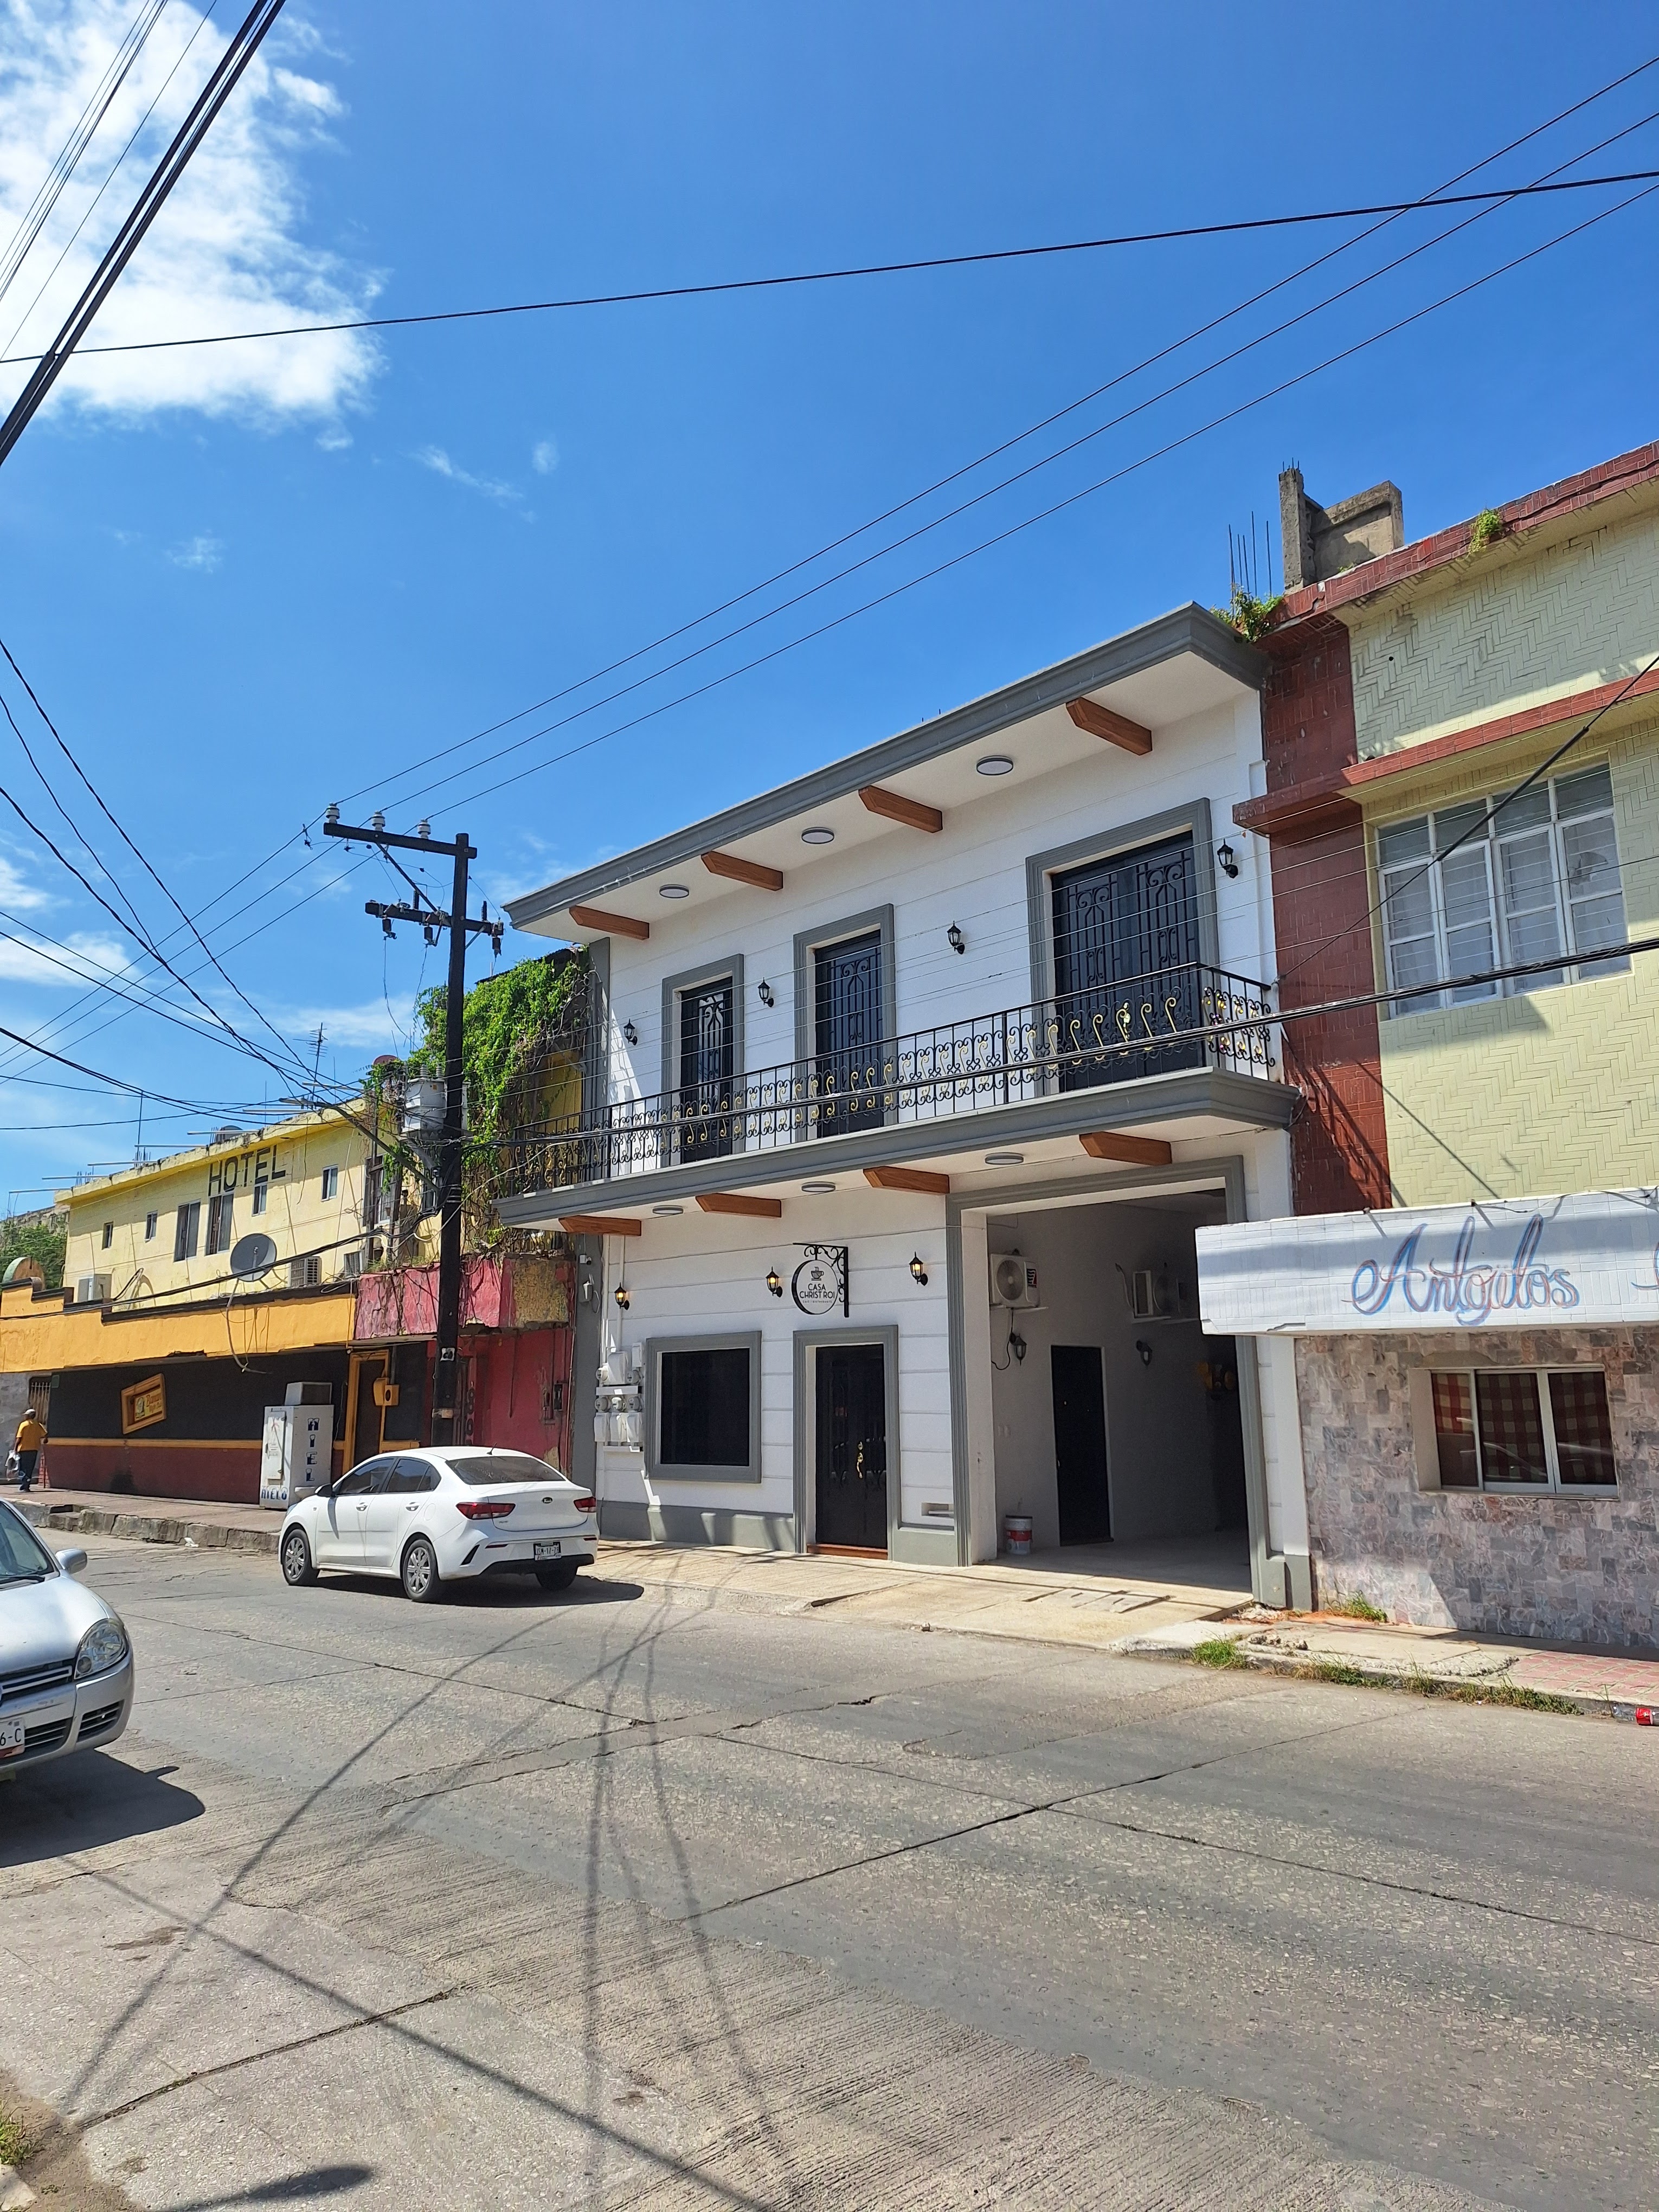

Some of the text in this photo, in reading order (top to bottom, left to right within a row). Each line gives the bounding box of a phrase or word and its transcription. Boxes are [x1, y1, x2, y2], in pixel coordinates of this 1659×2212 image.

[208, 1144, 286, 1197] HOTEL
[808, 1283, 826, 1291] CASA
[799, 1291, 835, 1299] CHRIST ROI
[261, 1486, 288, 1500] HIELO
